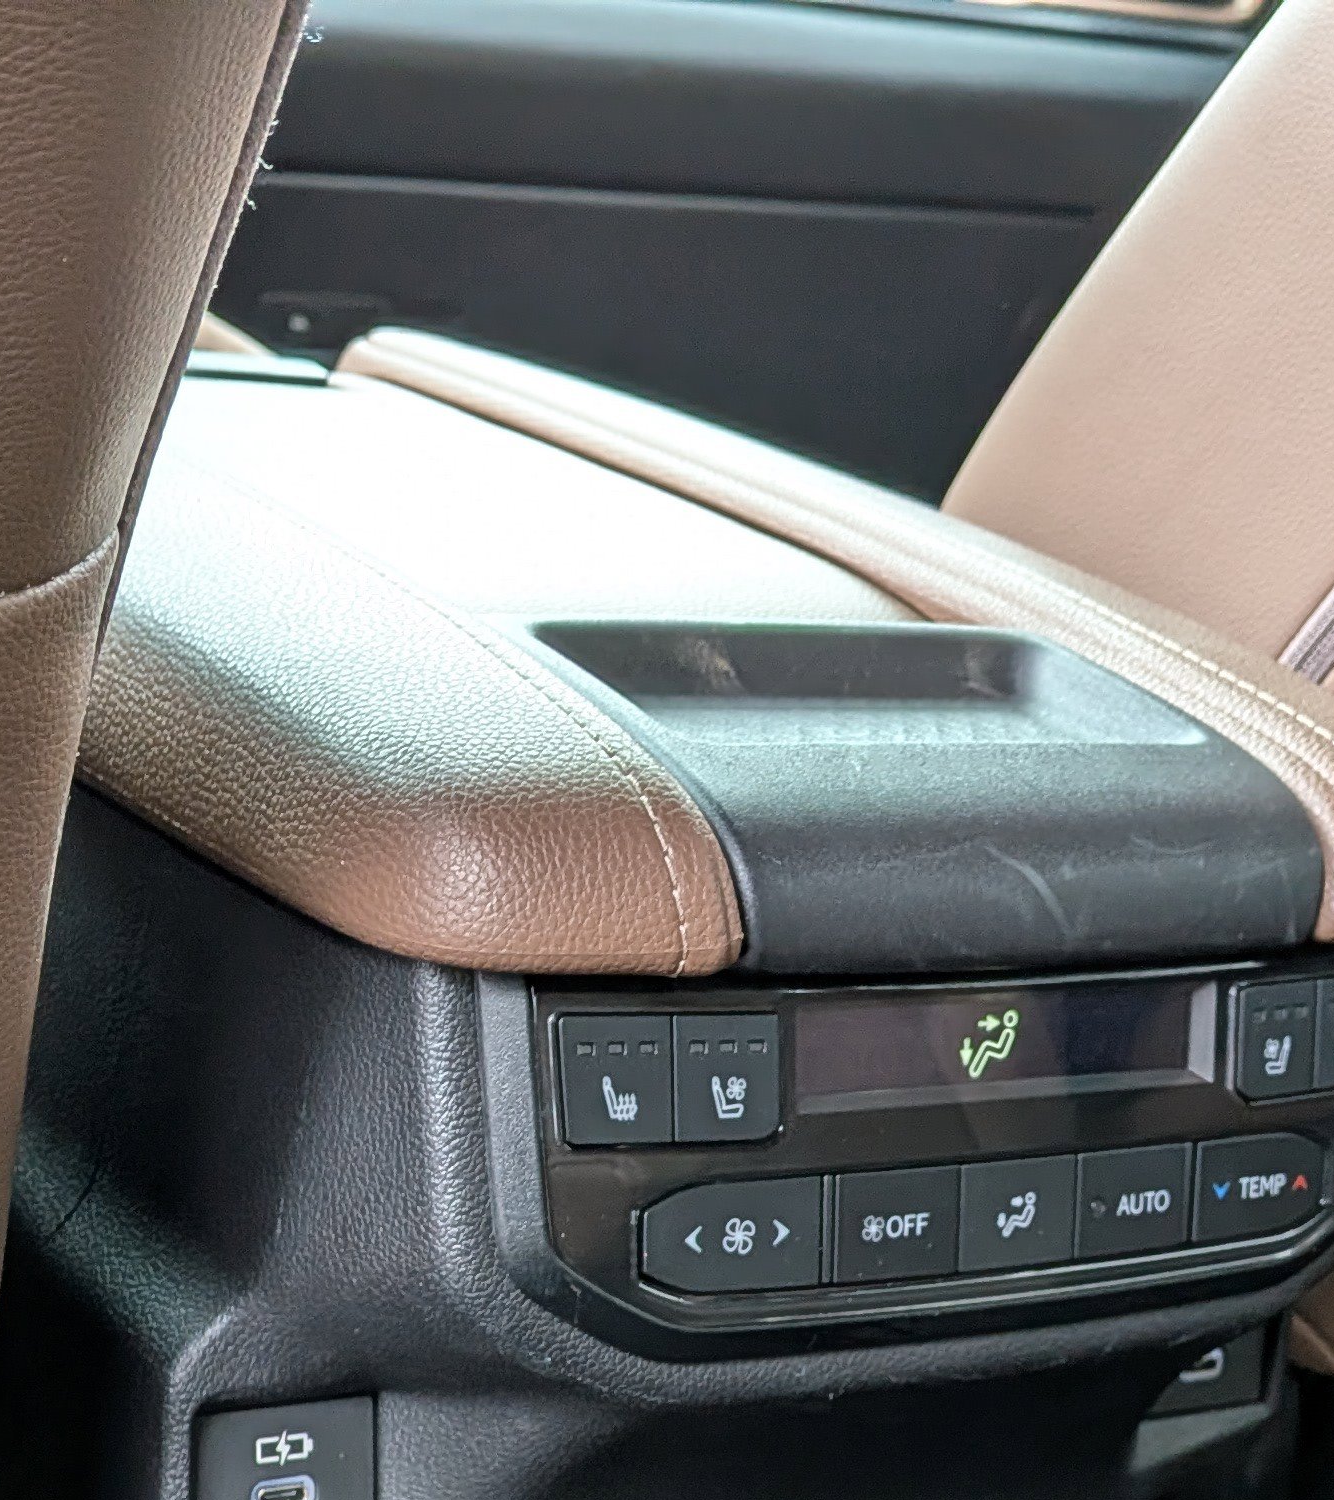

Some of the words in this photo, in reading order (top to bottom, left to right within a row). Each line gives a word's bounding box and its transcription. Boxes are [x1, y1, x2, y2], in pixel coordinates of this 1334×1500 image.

[1239, 1172, 1287, 1200] TEMP
[1117, 1189, 1171, 1216] AUTO
[886, 1212, 931, 1238] OFF
